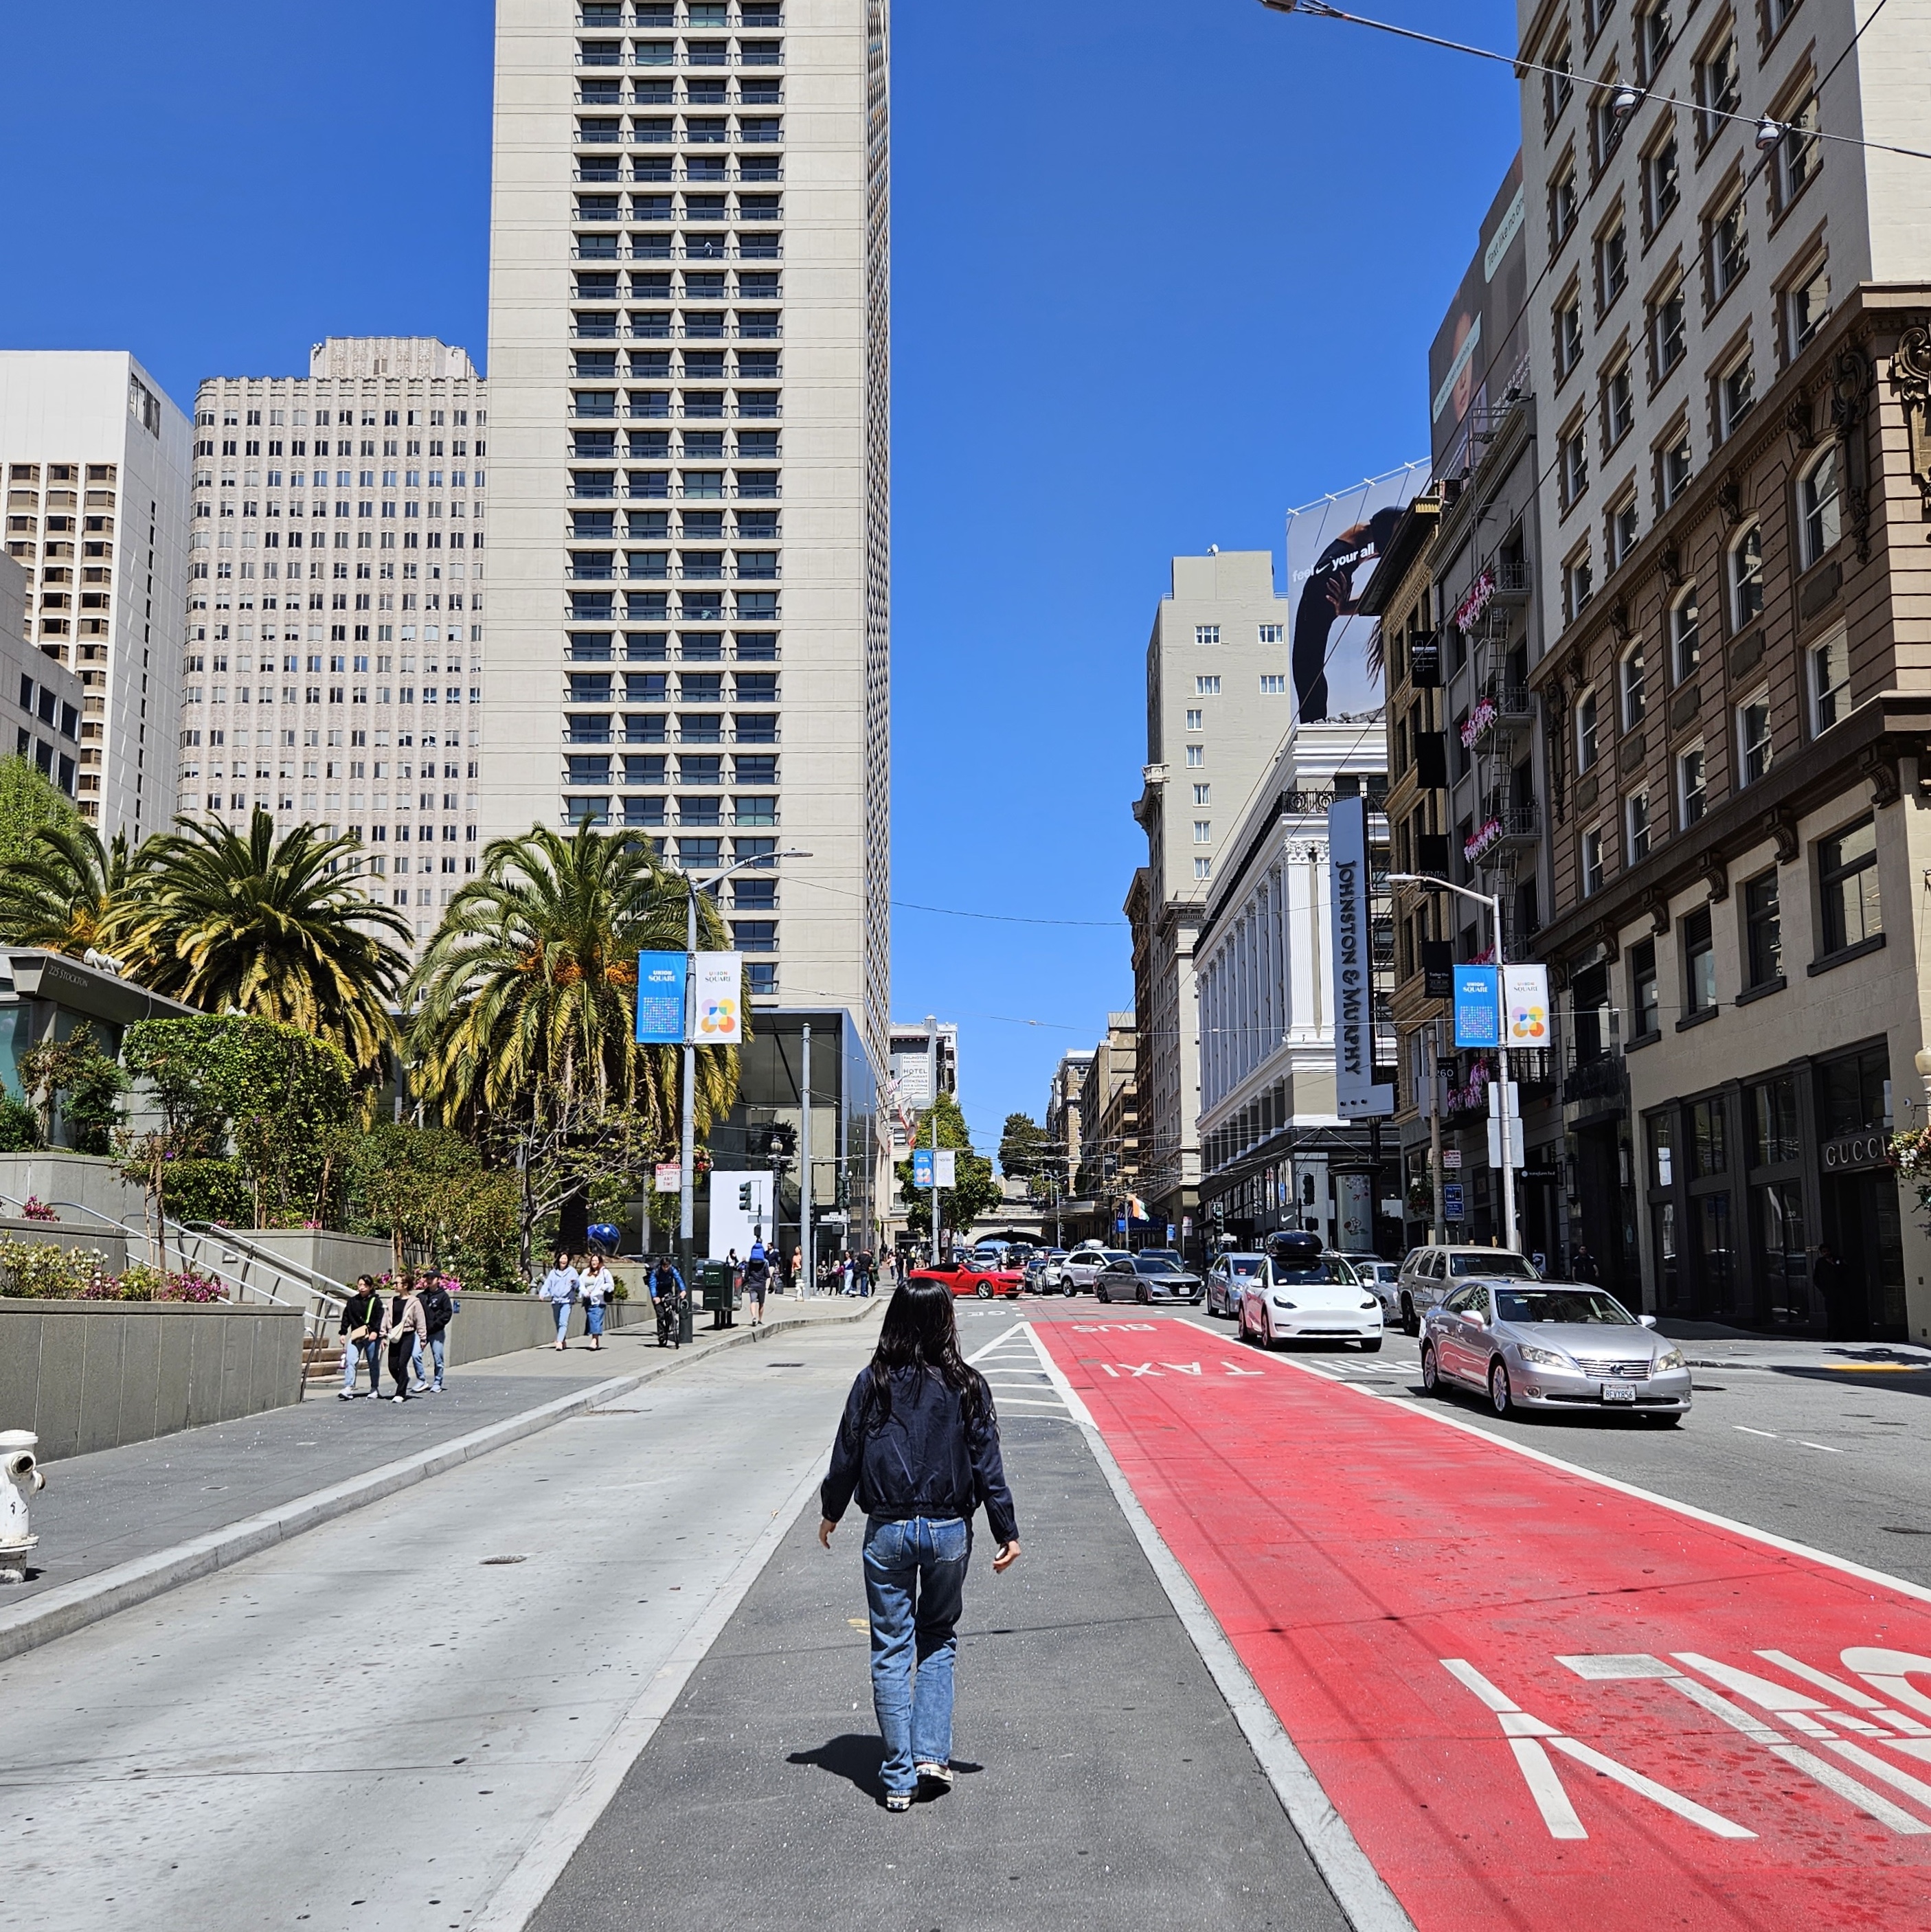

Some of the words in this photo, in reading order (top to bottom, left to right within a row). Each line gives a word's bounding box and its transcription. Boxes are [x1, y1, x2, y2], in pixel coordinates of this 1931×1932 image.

[1292, 564, 1315, 583] feel
[1331, 549, 1359, 572] your
[1359, 542, 1375, 558] all
[1335, 860, 1357, 965] JOHNSTON
[48, 965, 60, 977] 225
[59, 970, 89, 988] STOCKTON
[1342, 969, 1360, 986] &
[1342, 987, 1362, 1076] MURPHY
[1826, 1135, 1886, 1166] GUCCI
[1072, 1323, 1158, 1332] BUS
[1101, 1361, 1265, 1377] TAXI
